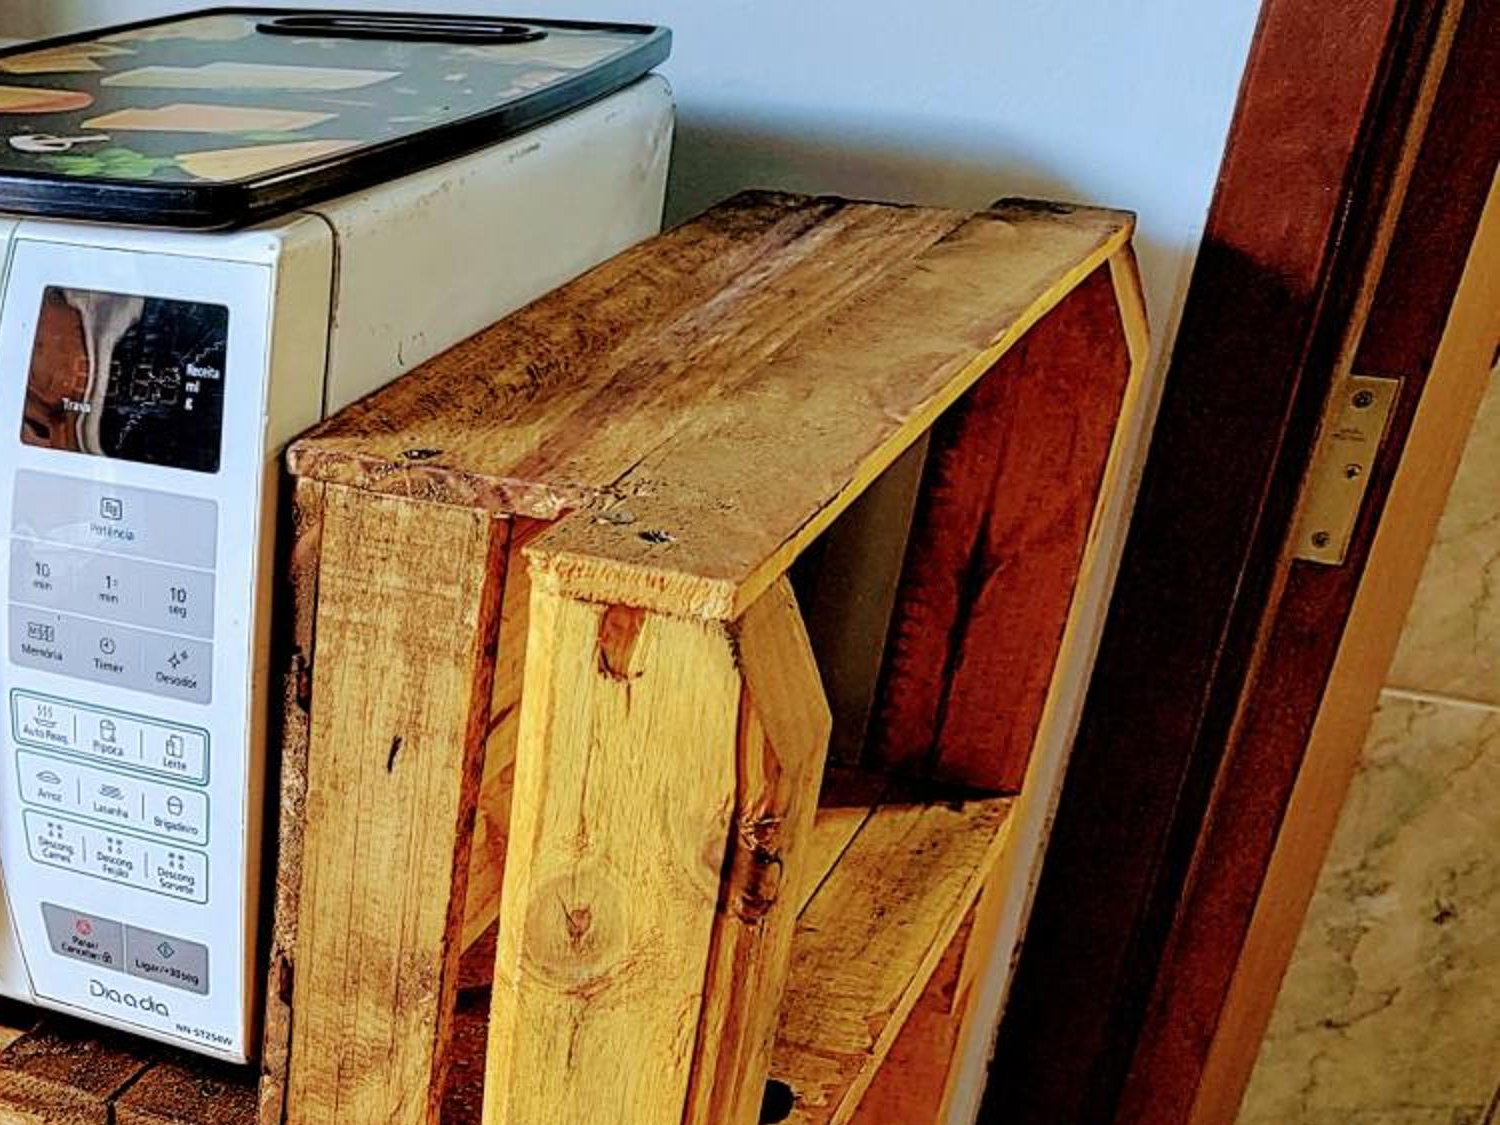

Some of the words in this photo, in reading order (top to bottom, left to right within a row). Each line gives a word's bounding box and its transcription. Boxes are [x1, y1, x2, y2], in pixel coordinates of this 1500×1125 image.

[185, 363, 221, 380] Receita
[185, 380, 201, 394] ml
[35, 562, 51, 577] 10
[33, 579, 52, 591] min
[99, 592, 119, 604] min
[170, 587, 188, 603] 10
[93, 657, 125, 674] Timer
[92, 740, 125, 757] Pipoca
[162, 757, 188, 771] Leite
[153, 816, 199, 836] Brigadeiro
